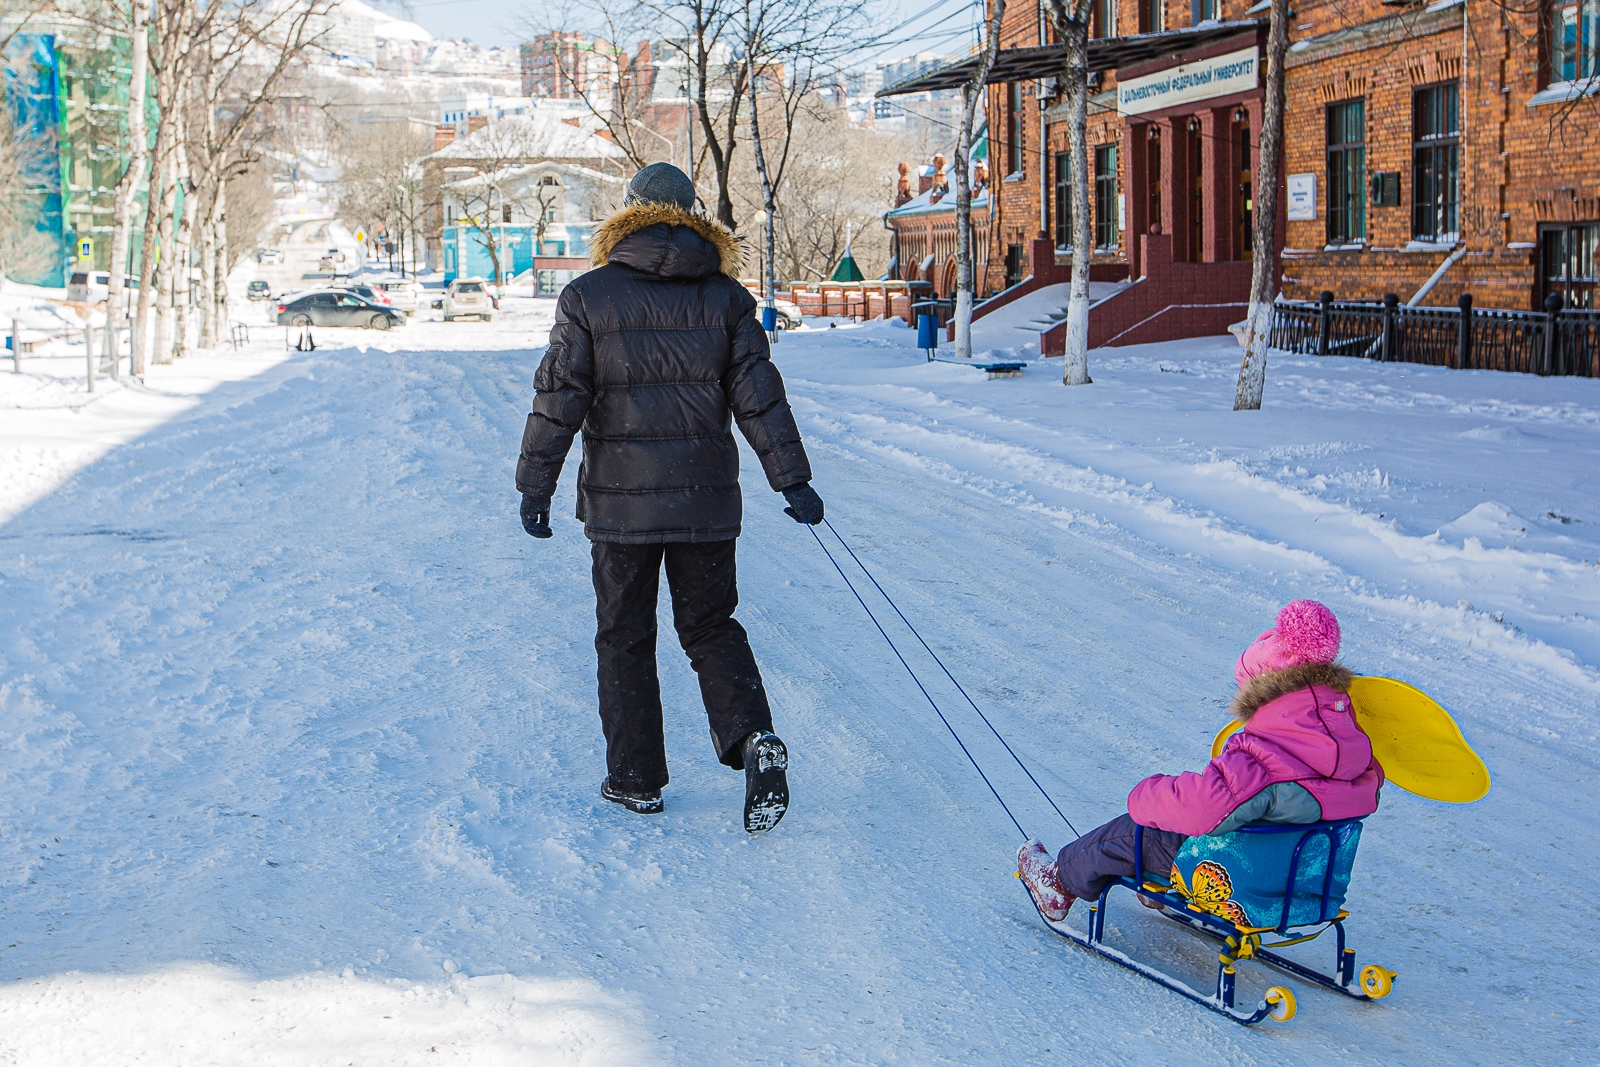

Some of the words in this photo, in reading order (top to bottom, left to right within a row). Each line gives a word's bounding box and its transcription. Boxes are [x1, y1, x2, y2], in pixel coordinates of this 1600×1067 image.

[1124, 76, 1171, 105] ДАЛЬНЕВОСТОЧНЫЙ
[1172, 65, 1212, 92] ФЕДЕРАЛЬНЫЙ
[1213, 58, 1254, 82] УНИВЕРСИТЕТ
